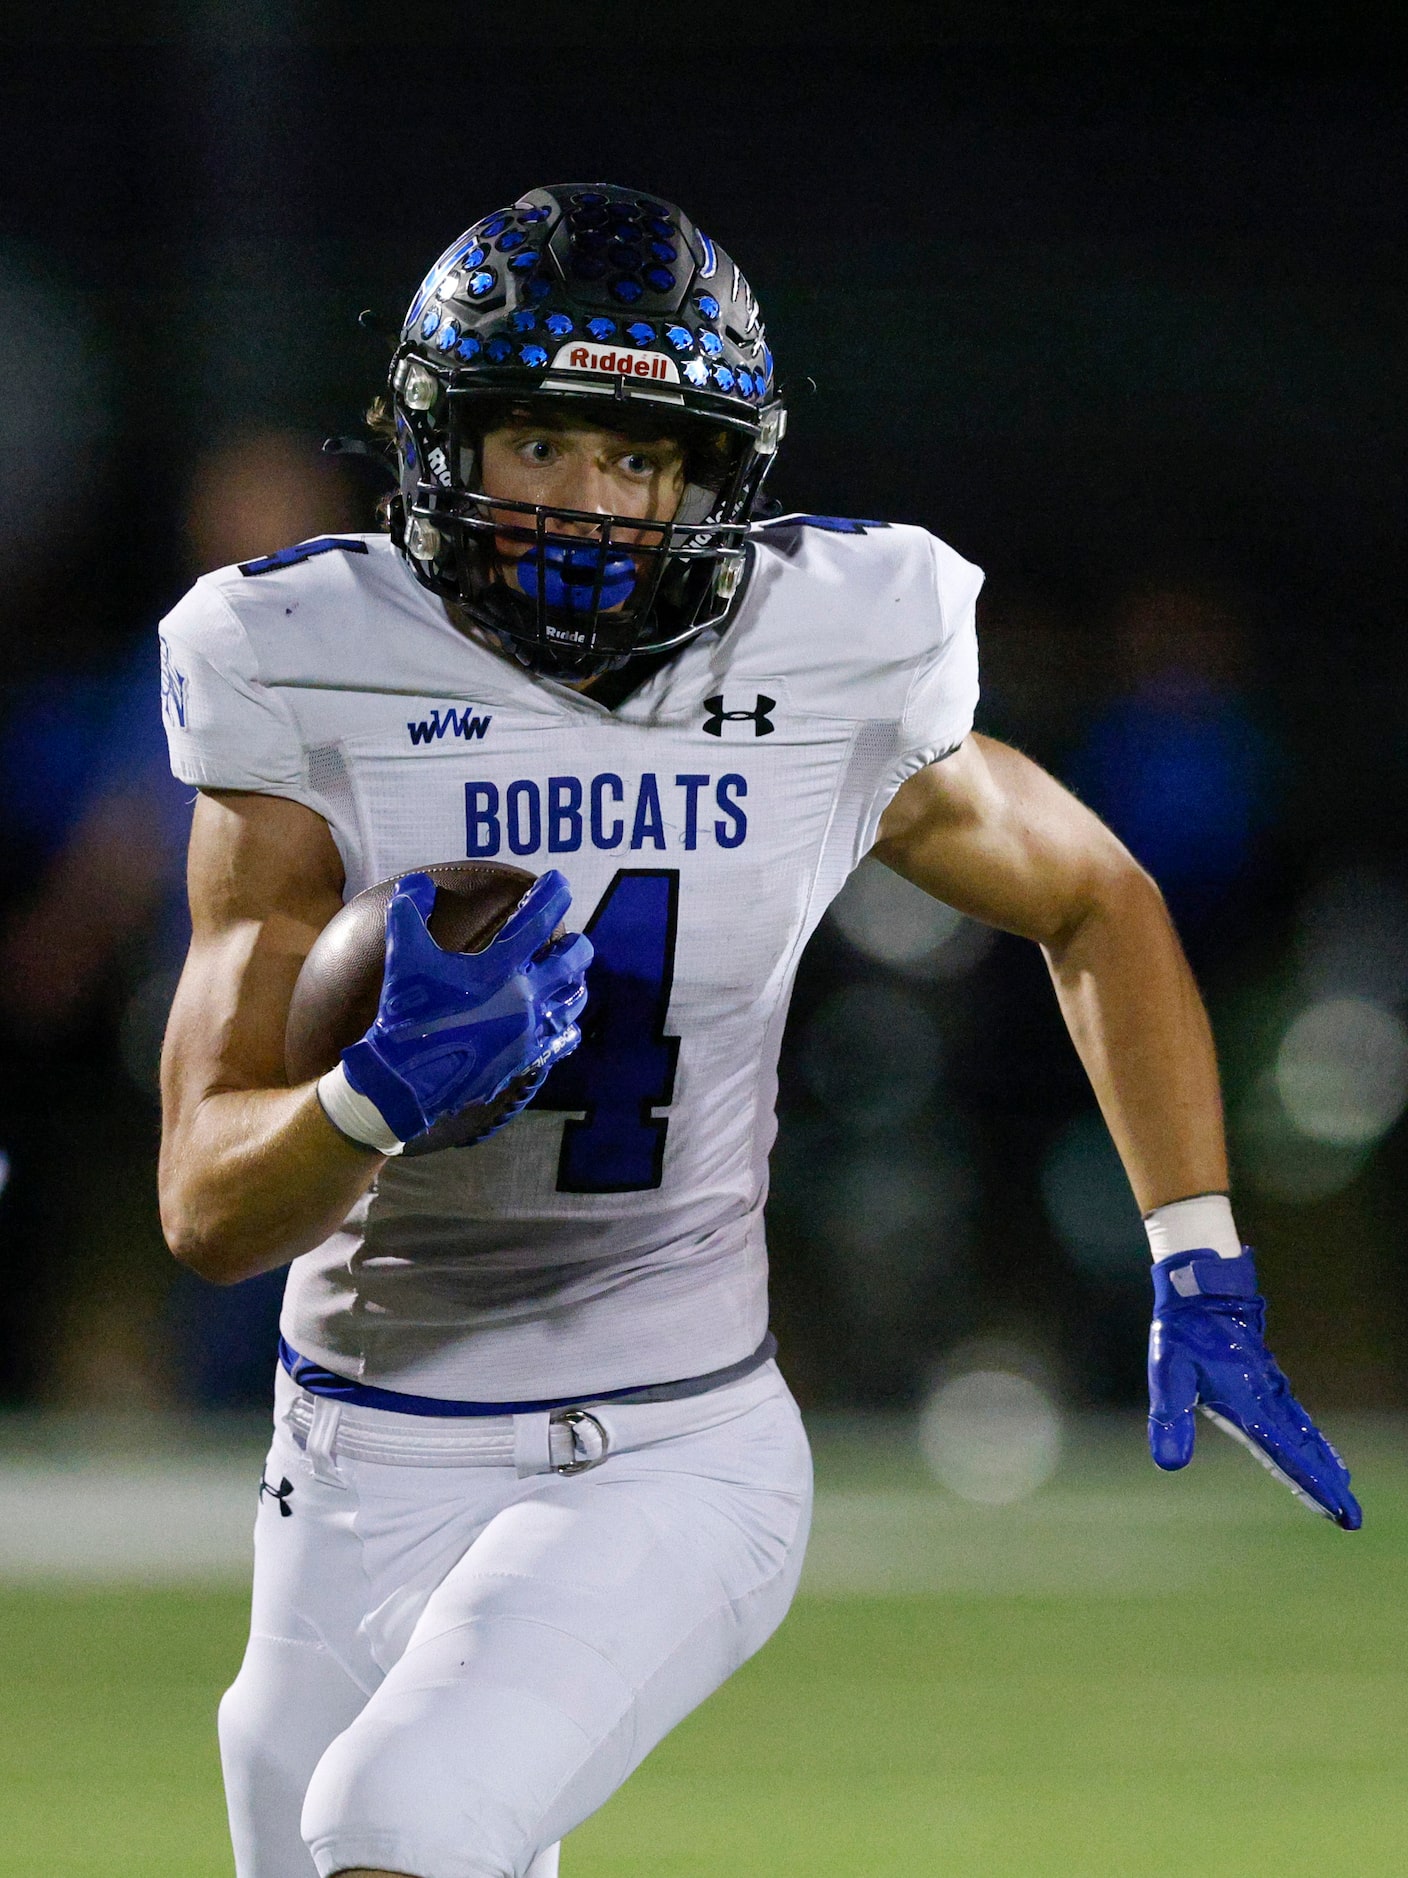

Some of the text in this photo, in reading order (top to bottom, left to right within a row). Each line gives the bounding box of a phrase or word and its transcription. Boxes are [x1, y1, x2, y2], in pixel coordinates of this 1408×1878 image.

[570, 347, 667, 379] Riddell
[545, 625, 597, 645] Riddel
[464, 773, 748, 858] BOBCATS
[525, 868, 682, 1194] 4
